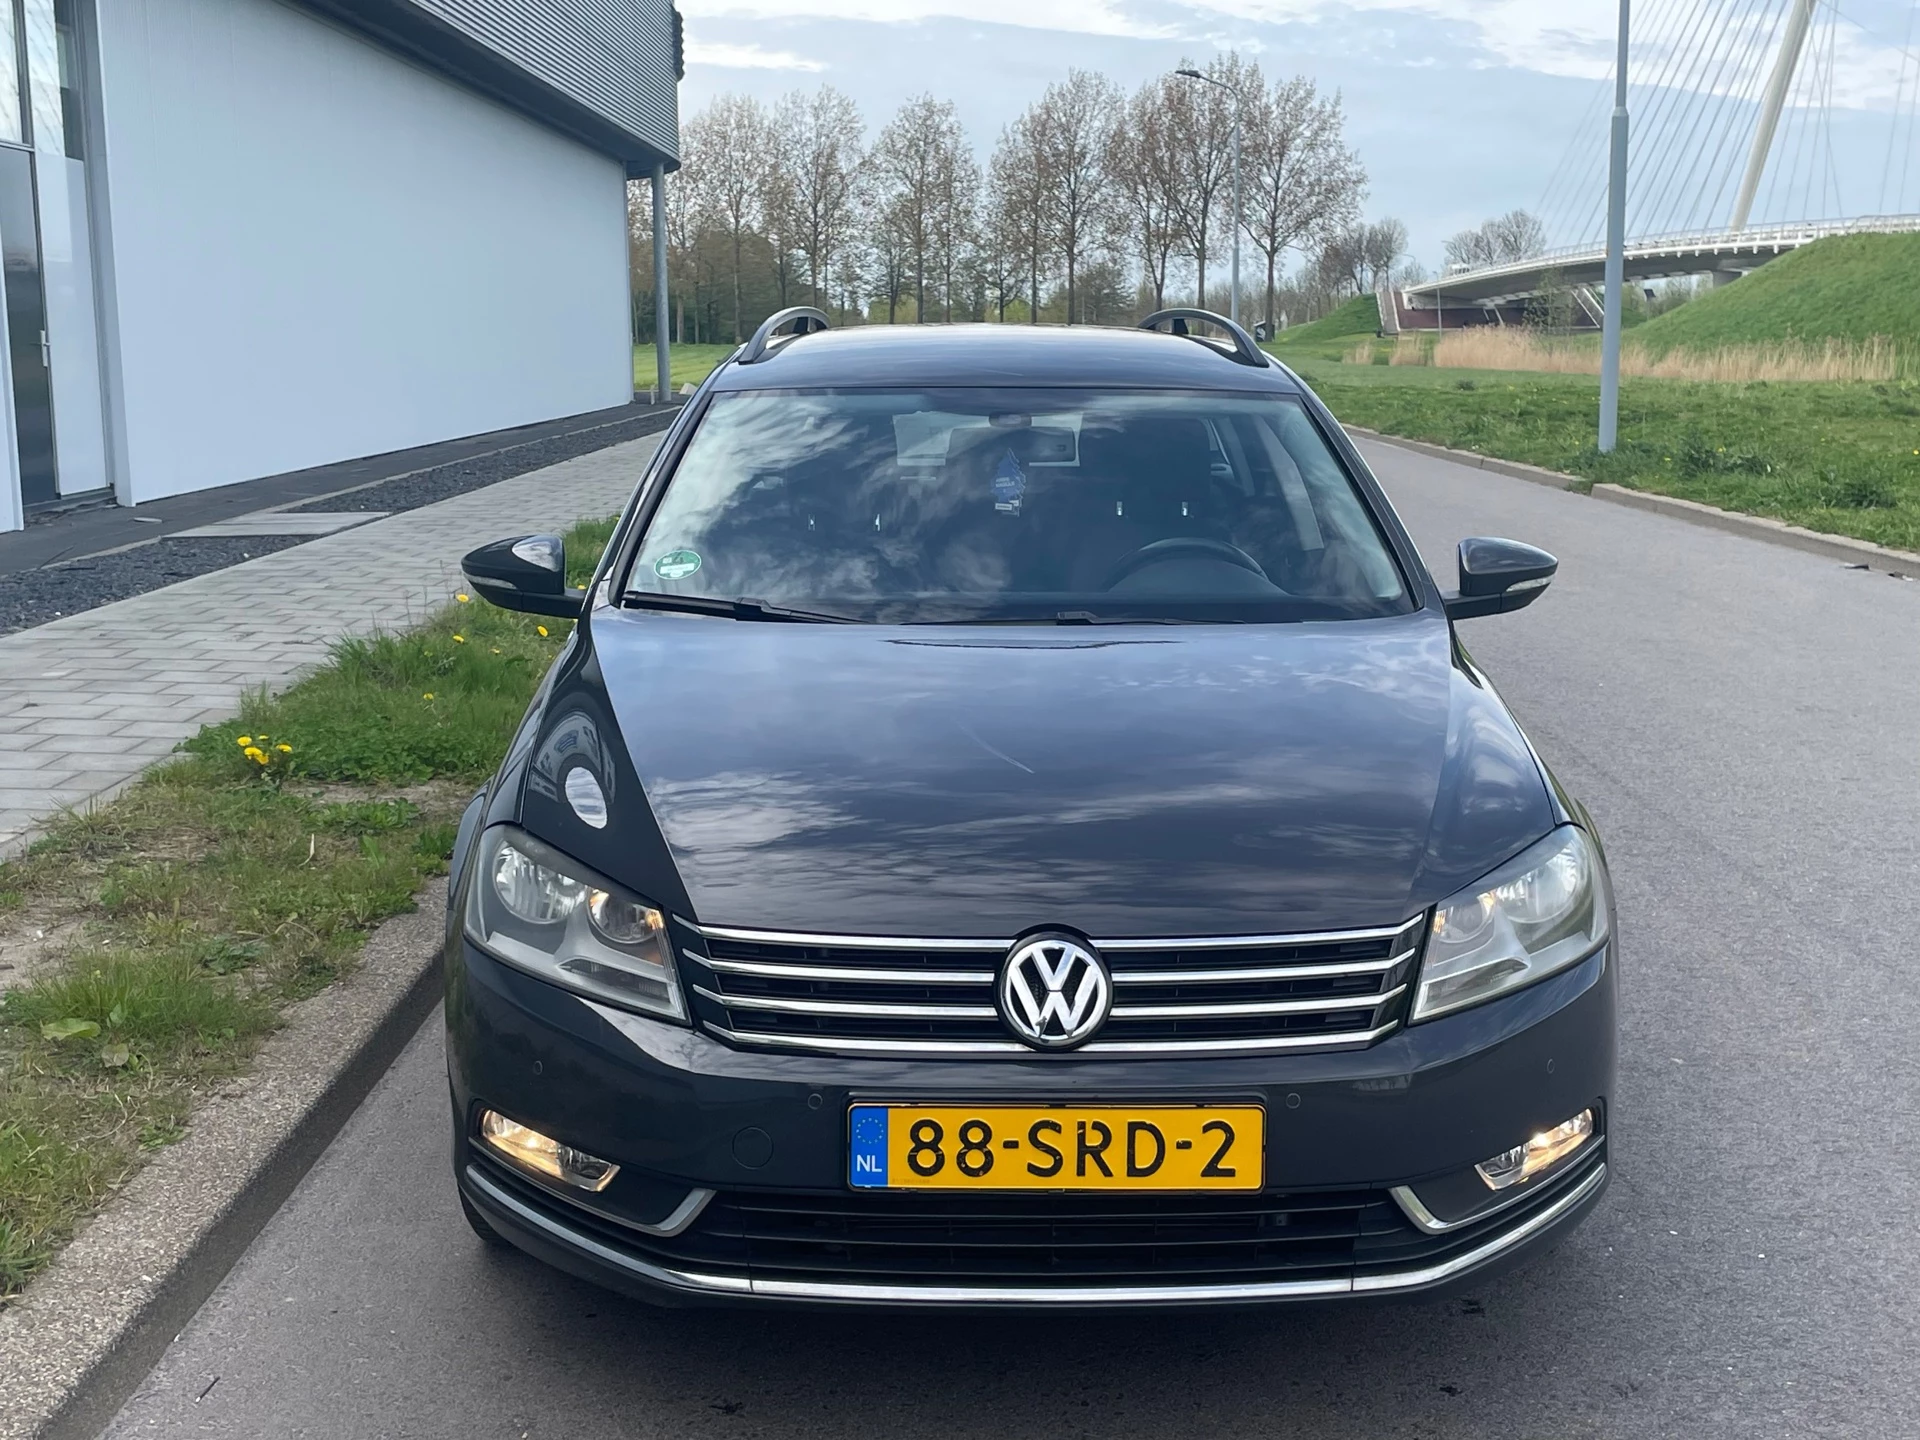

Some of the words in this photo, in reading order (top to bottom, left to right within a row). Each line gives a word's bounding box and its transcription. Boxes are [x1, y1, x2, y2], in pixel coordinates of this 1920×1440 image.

[1008, 942, 1103, 1040] VW
[856, 1154, 883, 1173] NL
[906, 1118, 1237, 1178] 88-SRD-2
